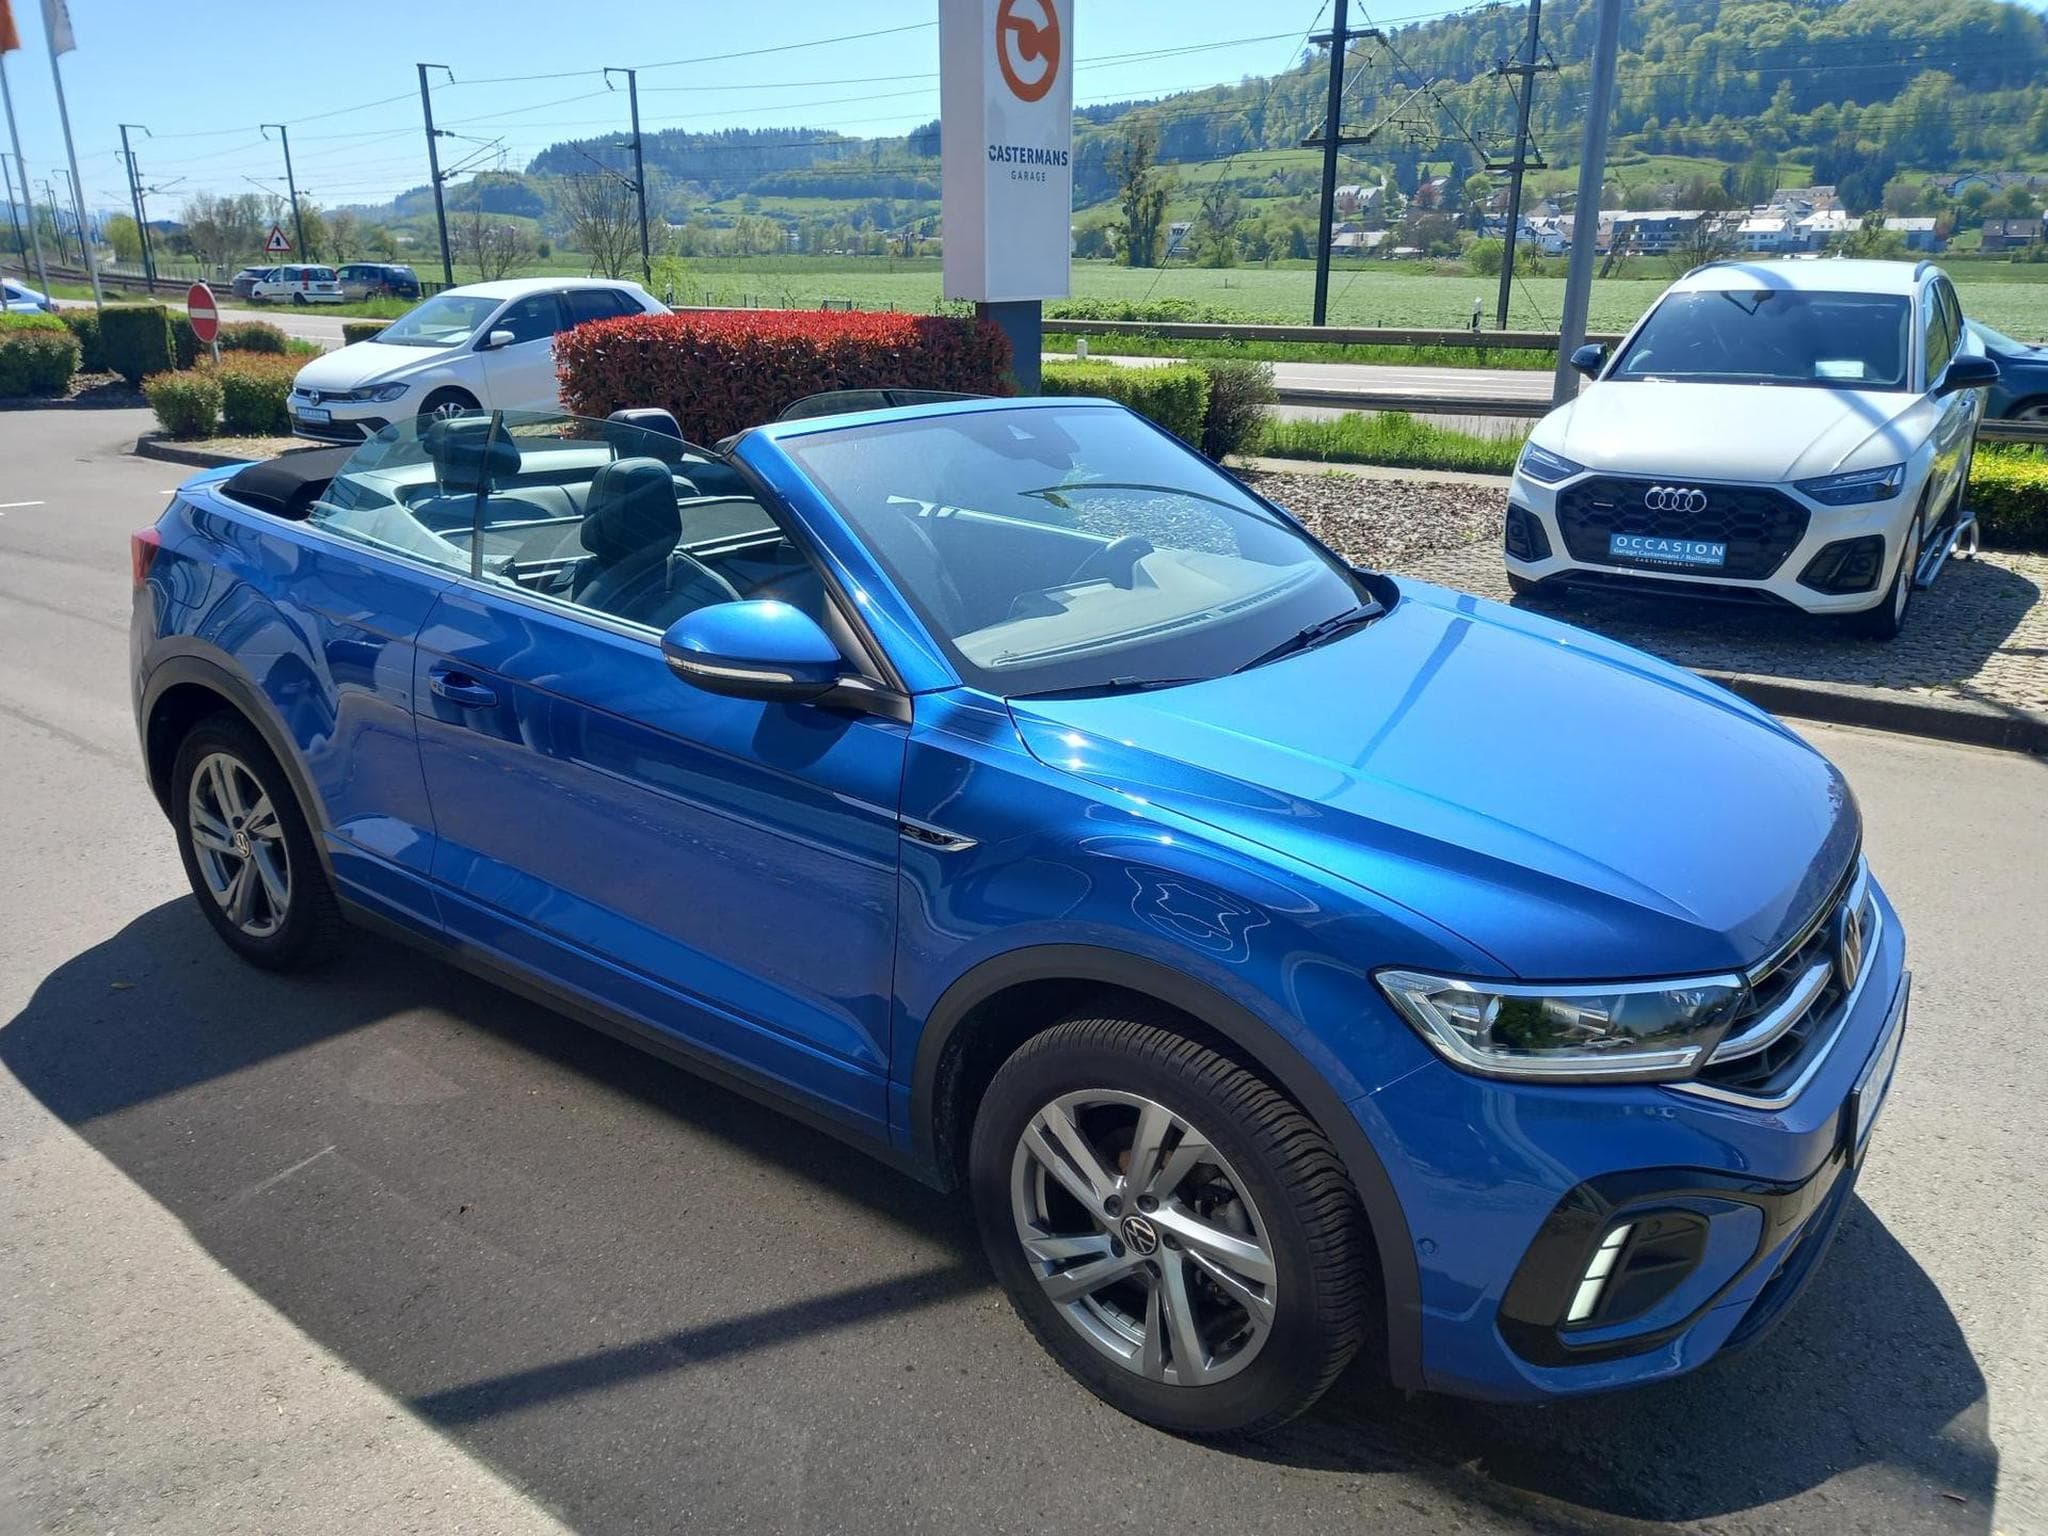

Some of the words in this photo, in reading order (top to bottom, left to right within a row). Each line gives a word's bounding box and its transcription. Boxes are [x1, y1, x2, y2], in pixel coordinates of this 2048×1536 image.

[988, 145, 1068, 166] CASTERMANS
[1011, 170, 1046, 182] GARAGE
[1613, 548, 1637, 556] Garage
[1616, 536, 1724, 556] OCCASION
